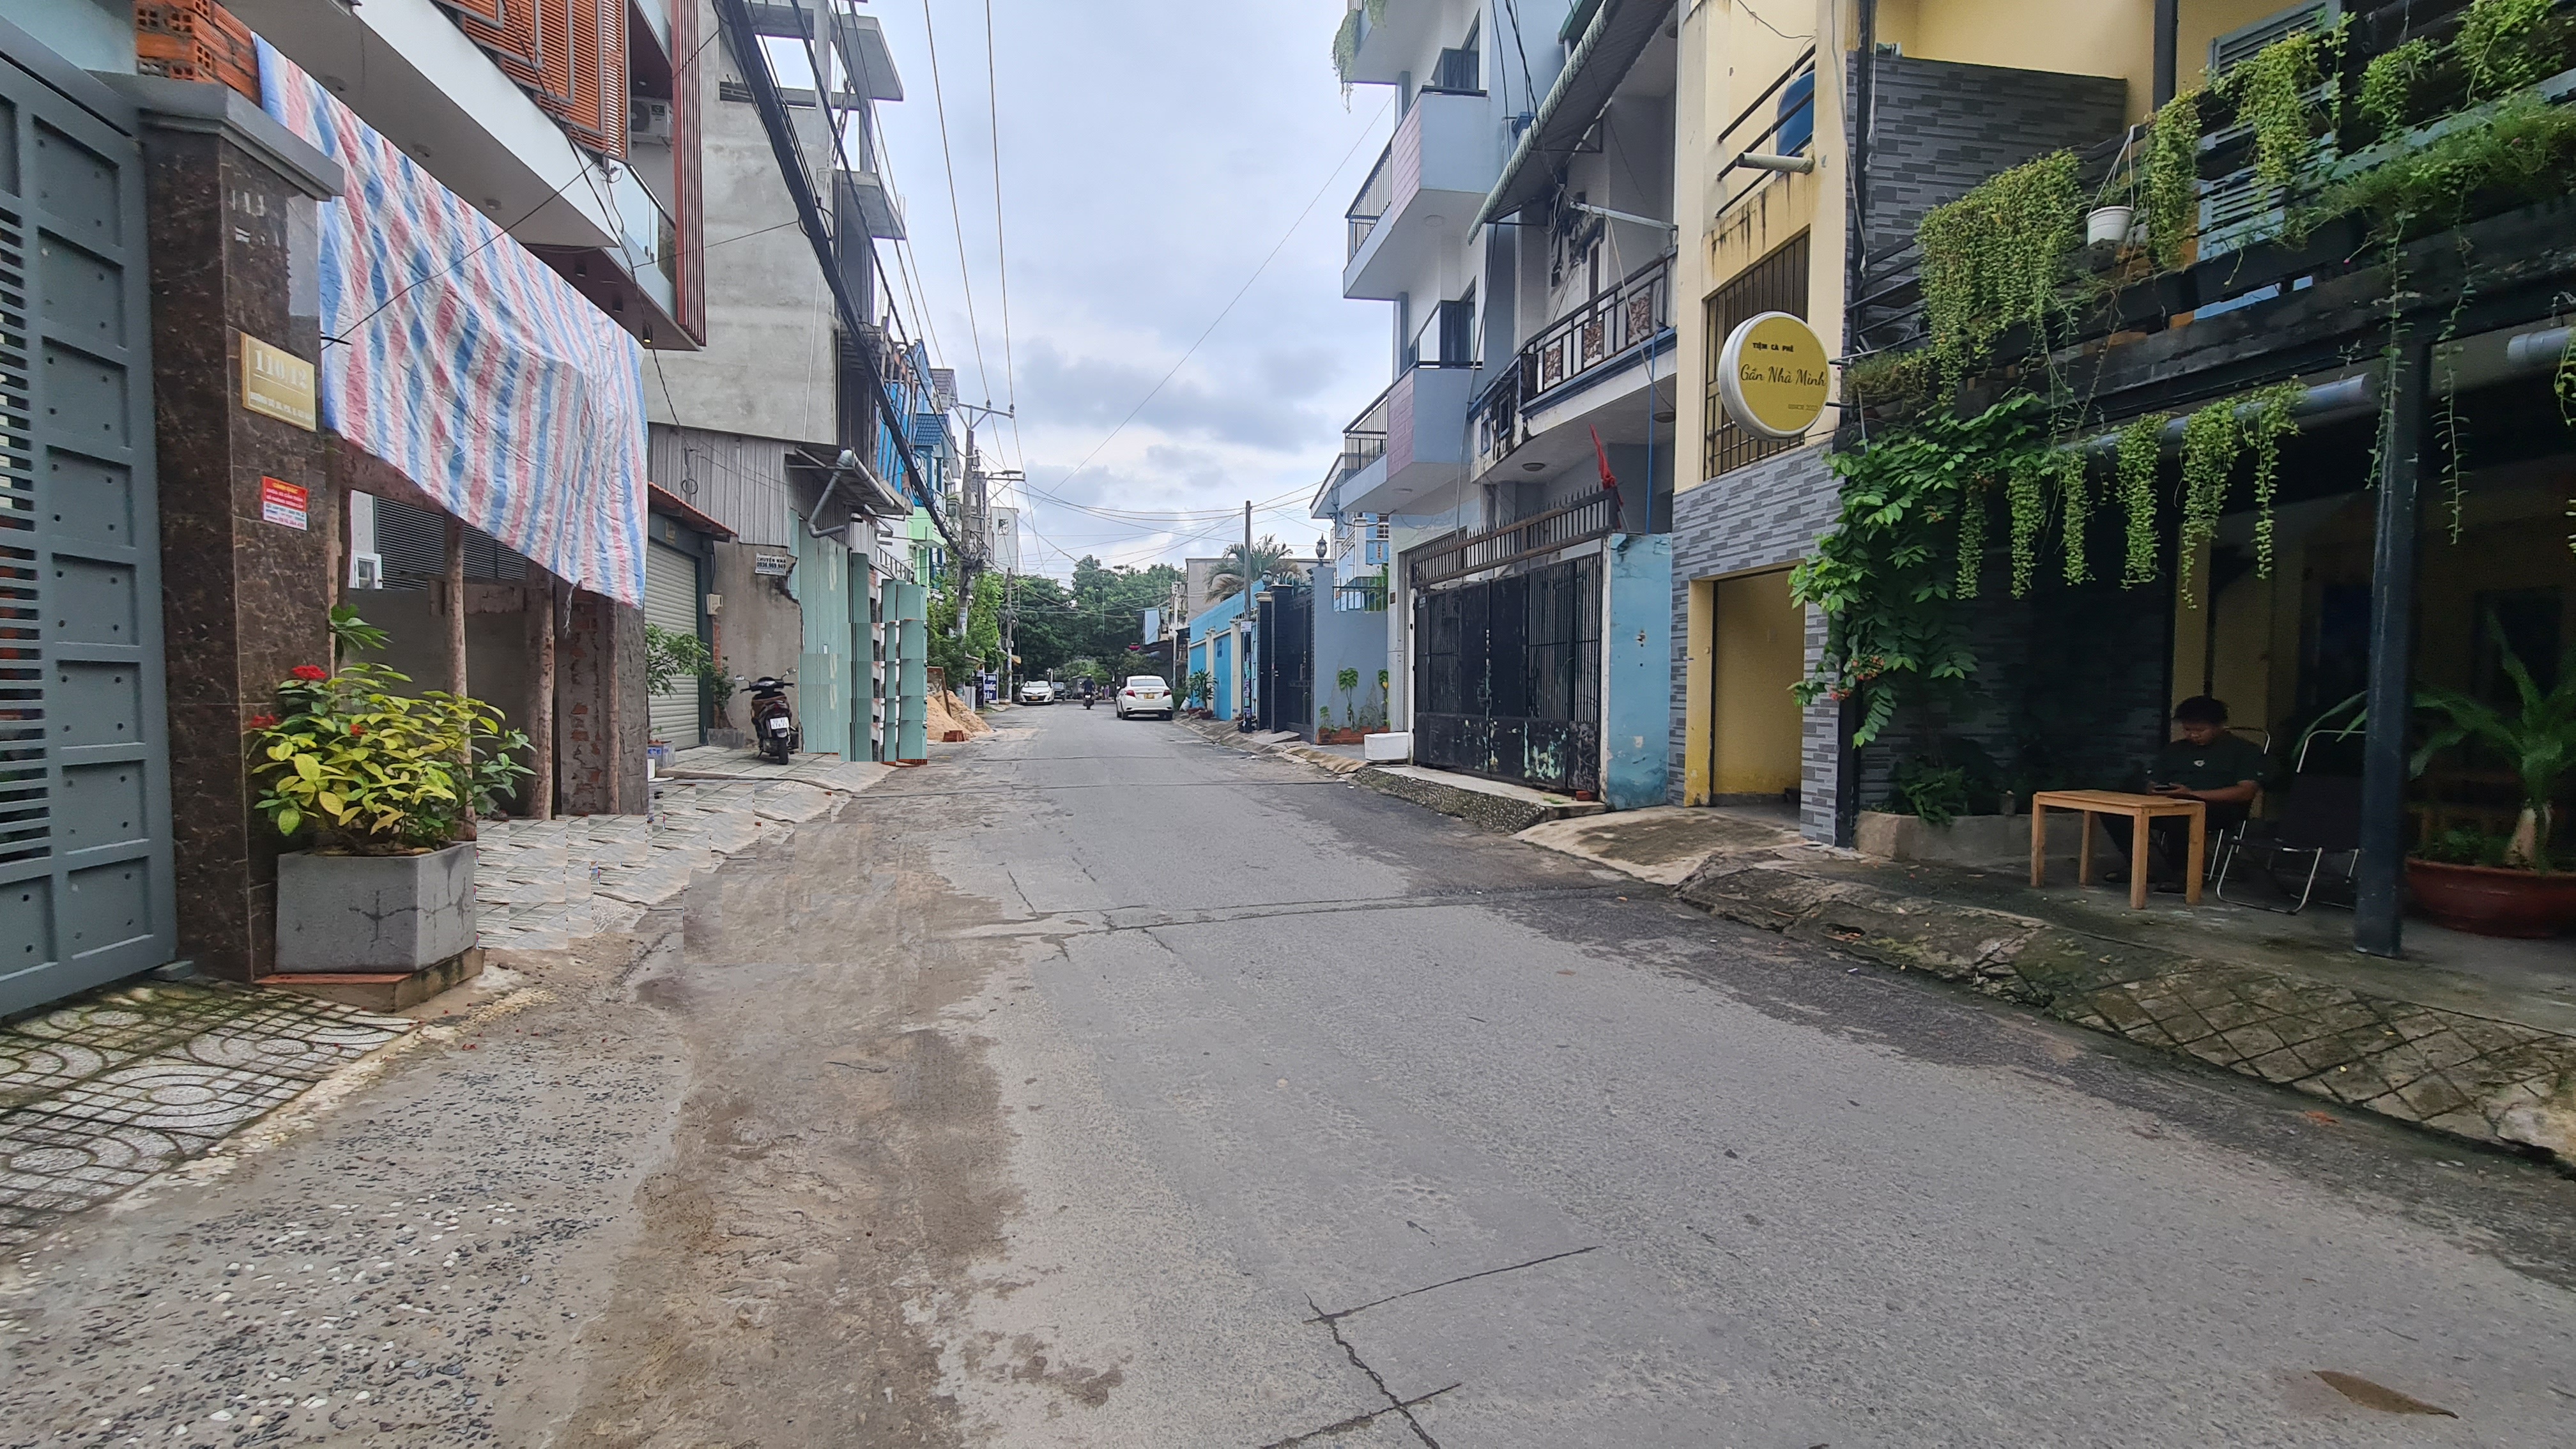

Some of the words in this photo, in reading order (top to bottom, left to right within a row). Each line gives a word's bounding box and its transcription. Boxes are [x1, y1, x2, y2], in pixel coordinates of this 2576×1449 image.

[1752, 342, 1768, 351] TIỆM
[1771, 342, 1779, 351] CÀ
[1740, 364, 1764, 381] Gần
[1768, 366, 1792, 383] Nhà
[1795, 369, 1827, 387] Mình
